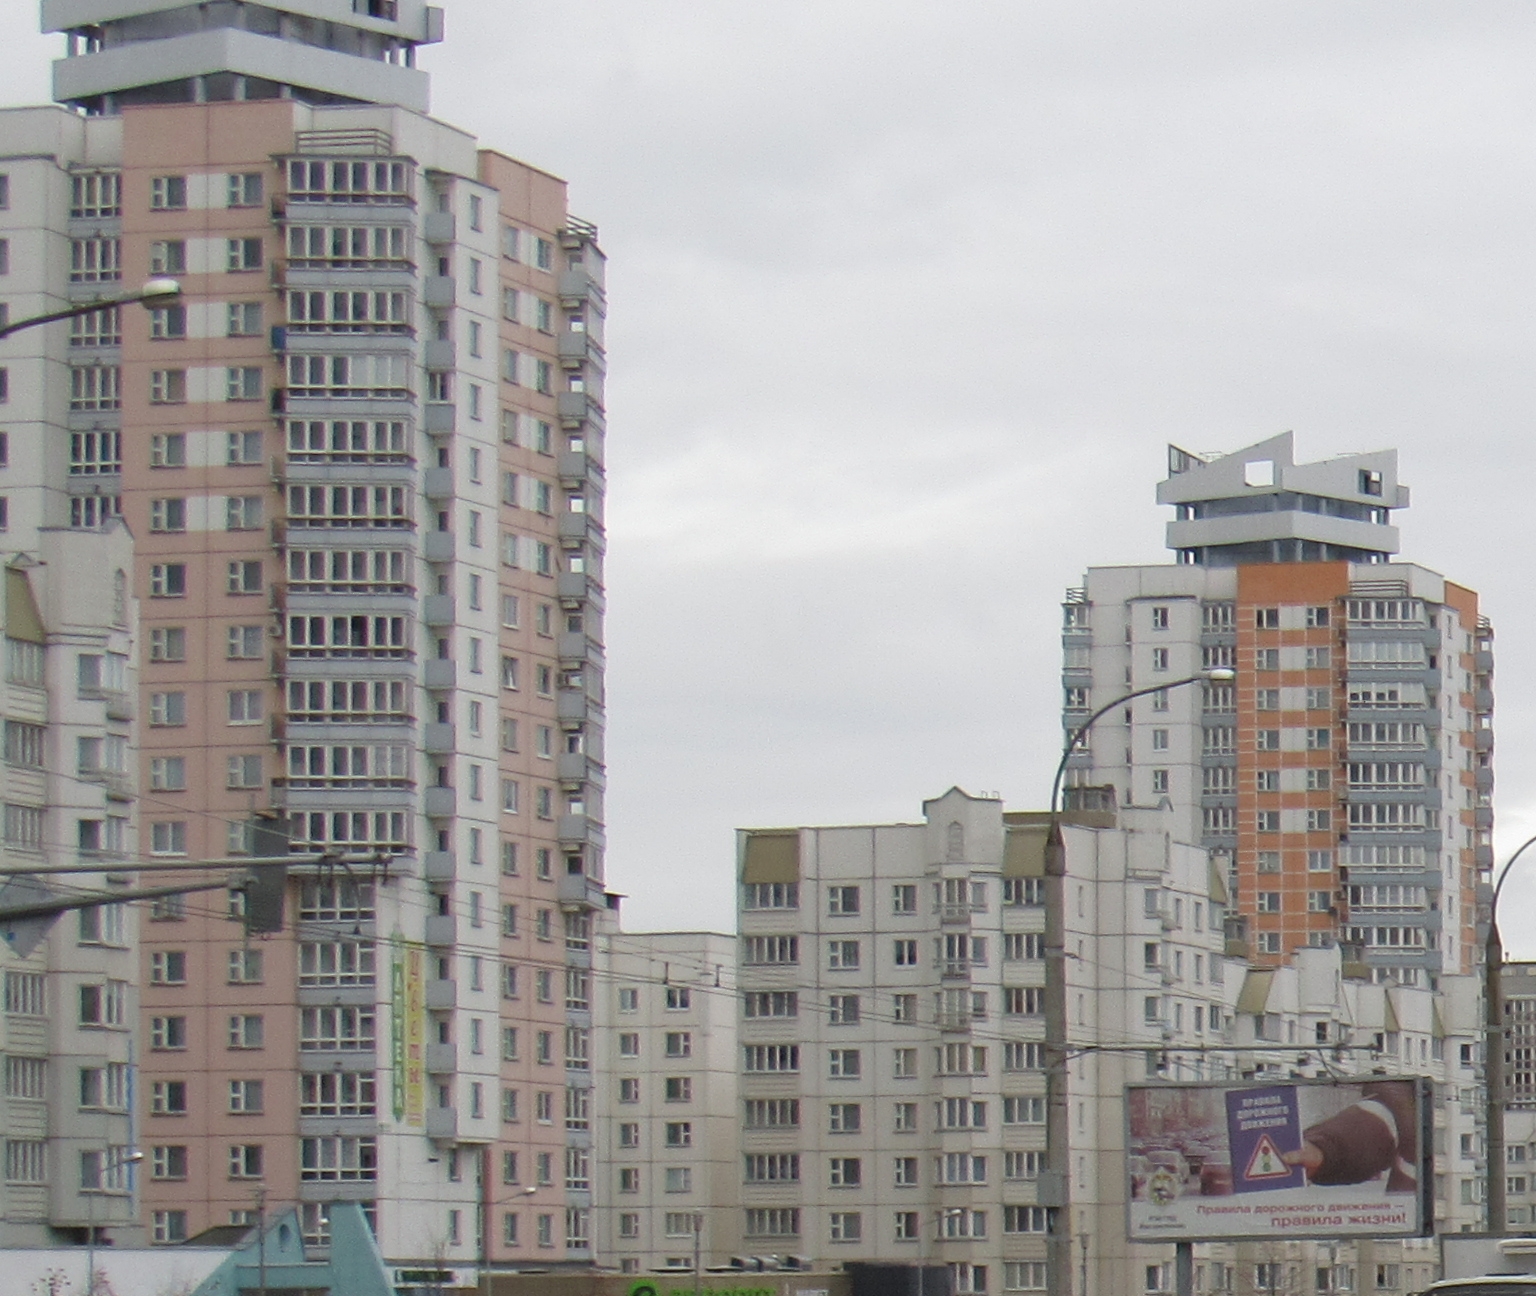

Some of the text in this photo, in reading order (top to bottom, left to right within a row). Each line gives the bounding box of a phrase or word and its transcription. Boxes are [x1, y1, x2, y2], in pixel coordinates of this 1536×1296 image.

[1197, 1205, 1250, 1214] Правила
[1255, 1204, 1325, 1214] дорожного
[1328, 1203, 1391, 1212] движения
[1271, 1213, 1406, 1228] правила жизни!
